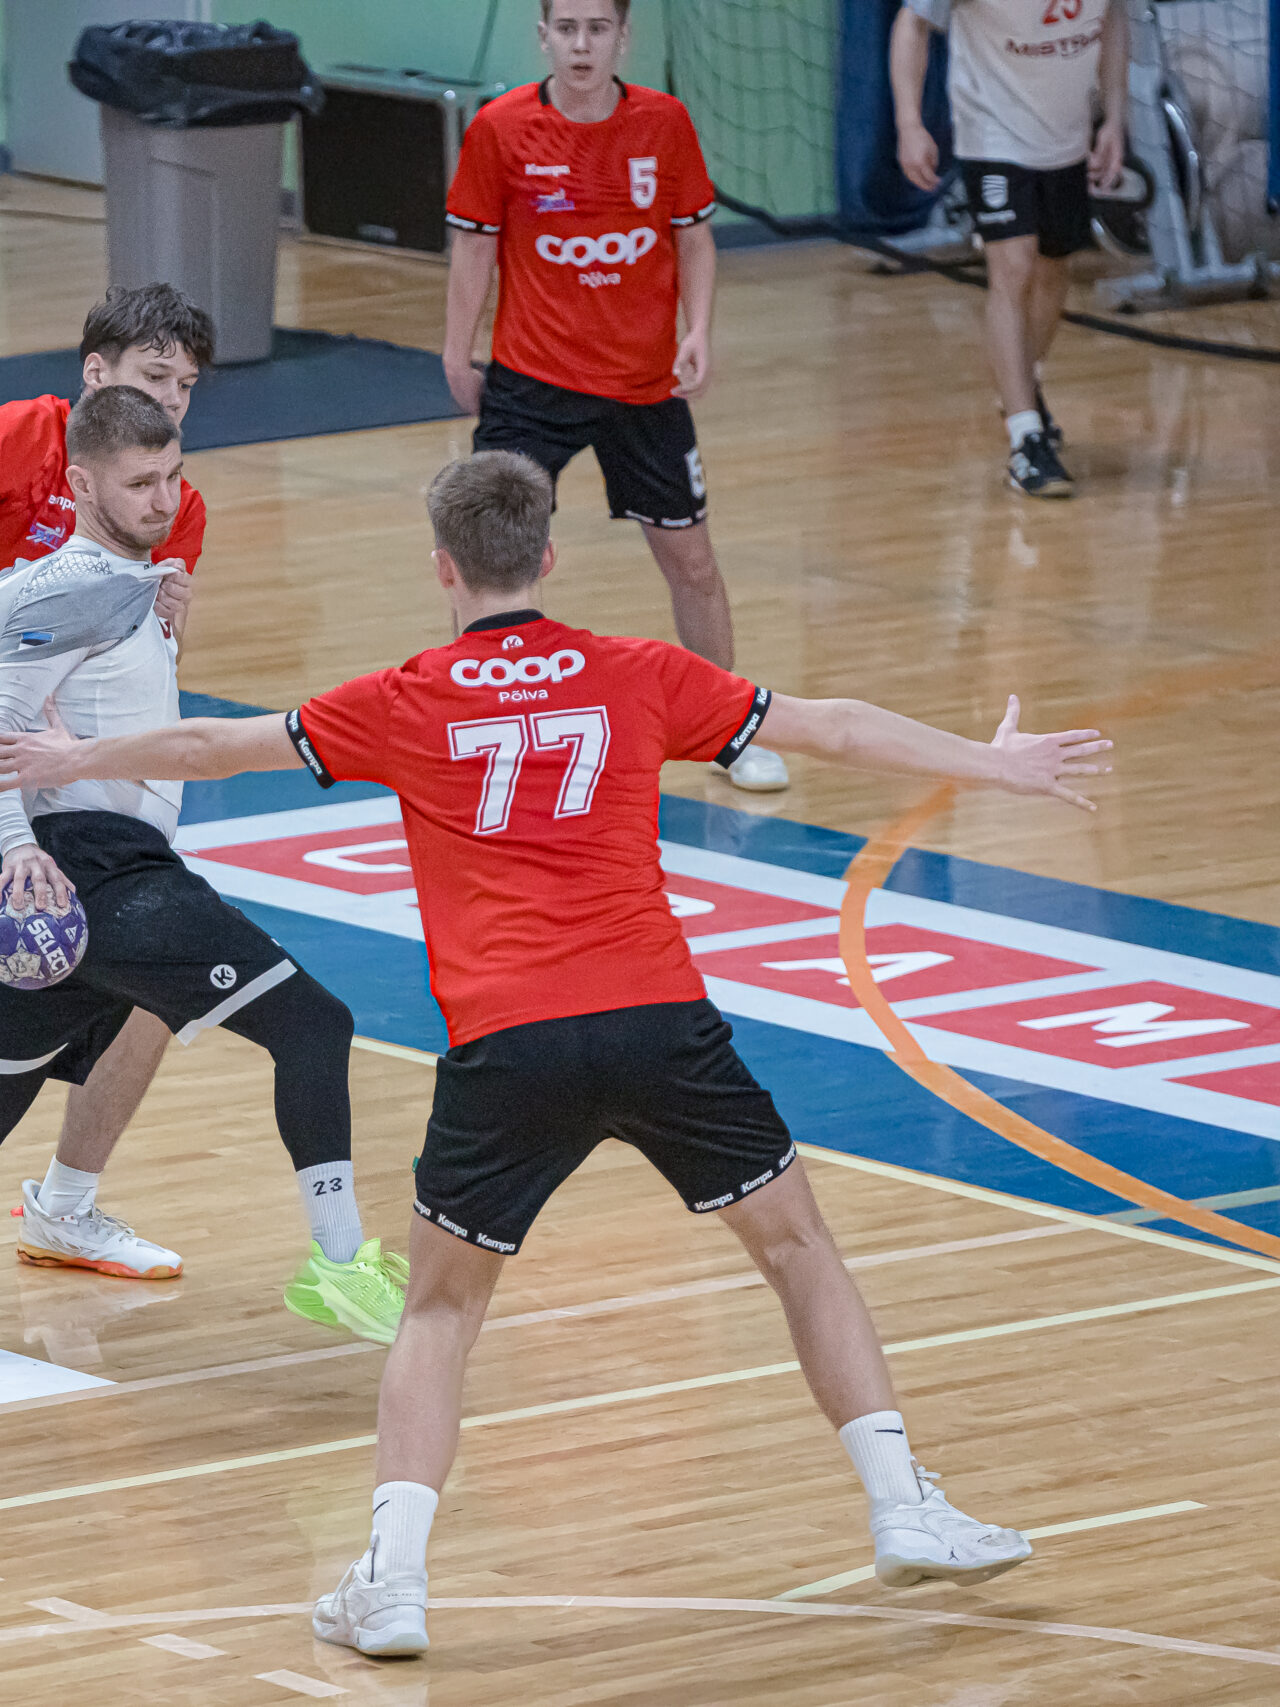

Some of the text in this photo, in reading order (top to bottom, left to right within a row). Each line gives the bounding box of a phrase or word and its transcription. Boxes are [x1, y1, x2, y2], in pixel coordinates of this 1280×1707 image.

[628, 156, 657, 209] 5
[535, 227, 657, 267] coop
[450, 649, 586, 688] coop
[498, 688, 549, 704] Põlva
[730, 712, 760, 751] Kempa
[298, 736, 323, 775] Kempa
[446, 704, 611, 836] 77
[312, 1177, 343, 1196] 23
[741, 1169, 773, 1193] Kempa
[695, 1193, 734, 1211] Kempa
[438, 1213, 468, 1238] Kempa
[477, 1232, 516, 1252] Kempa
